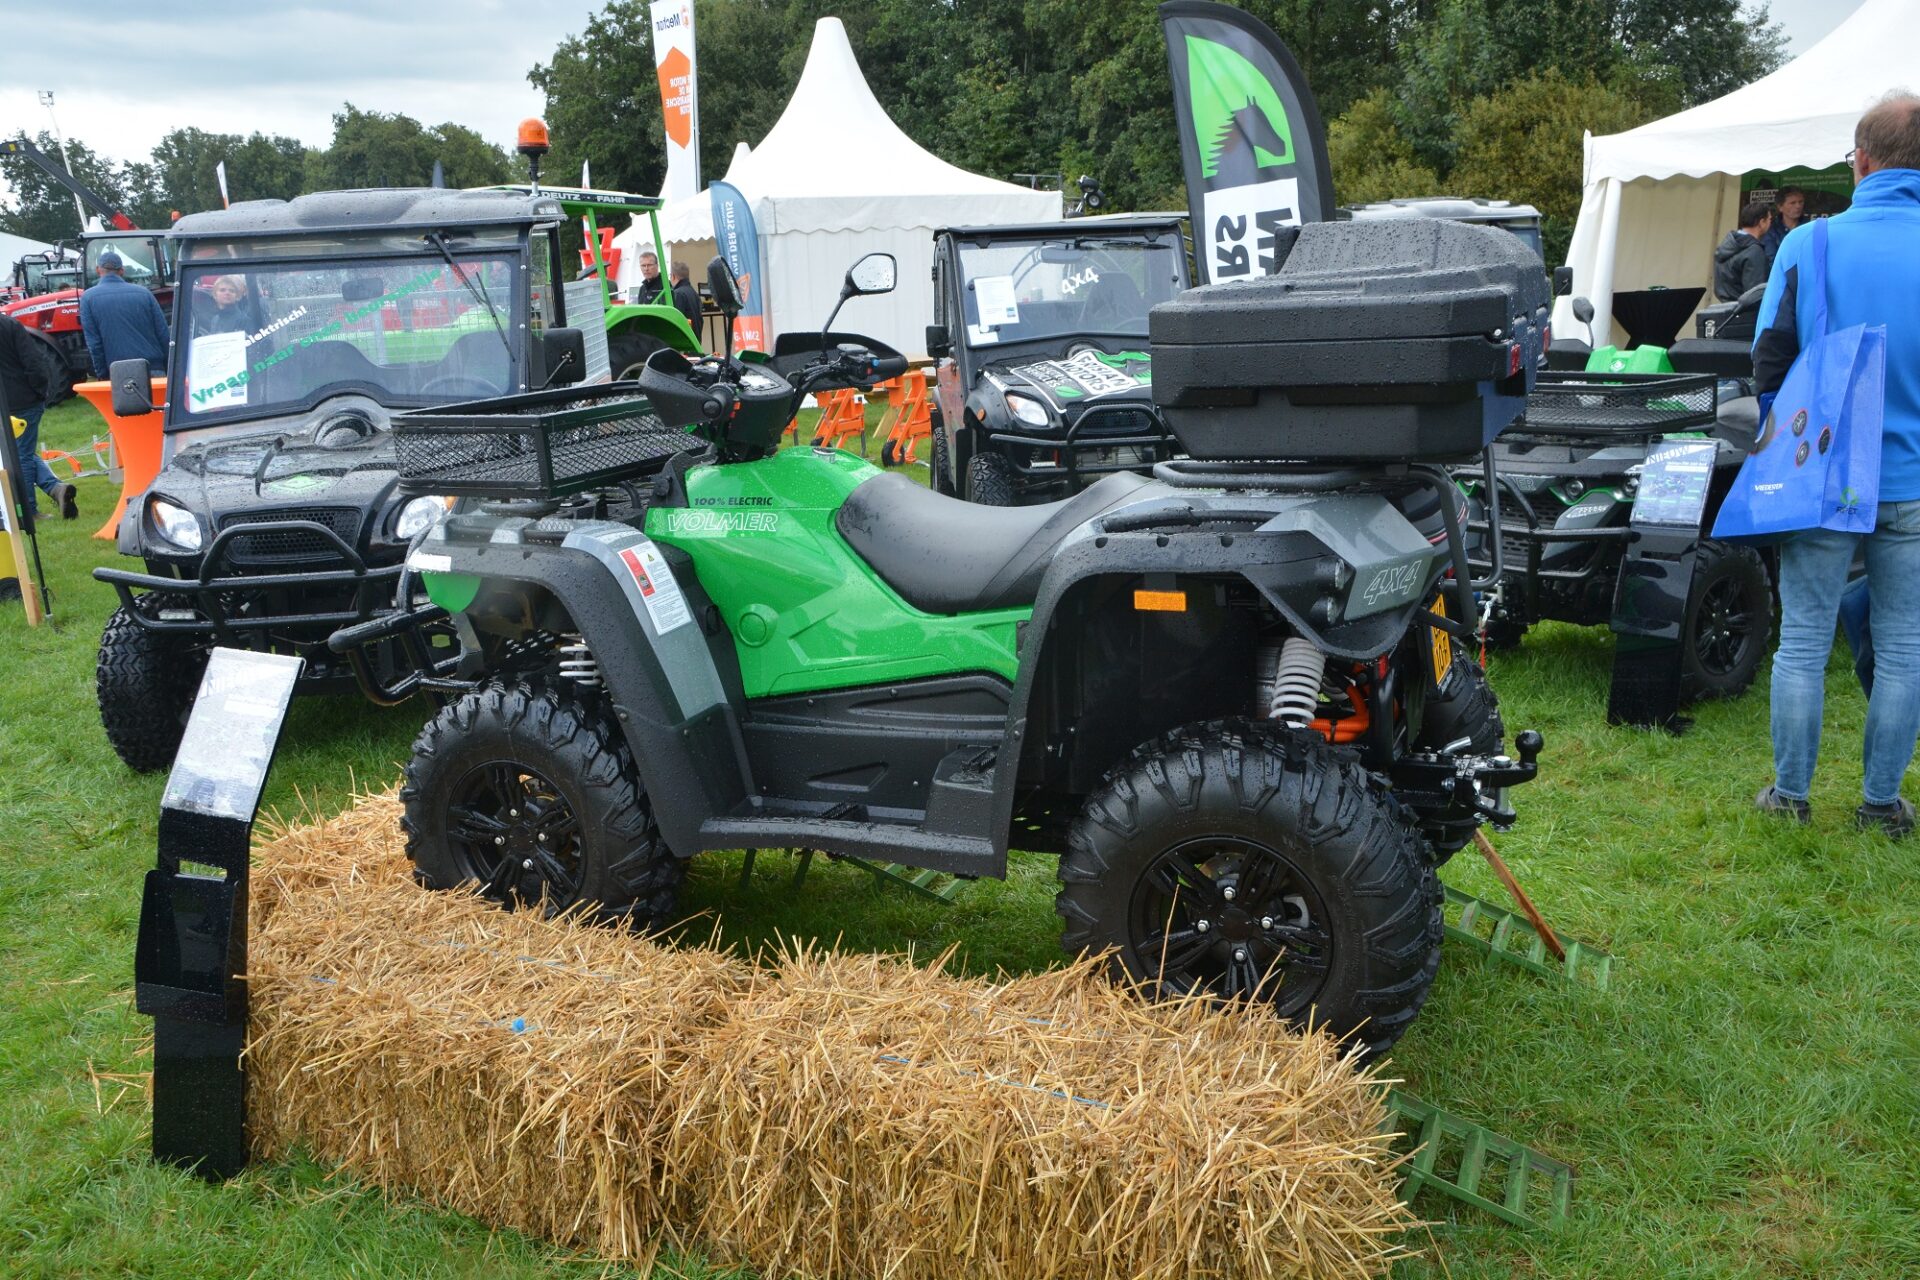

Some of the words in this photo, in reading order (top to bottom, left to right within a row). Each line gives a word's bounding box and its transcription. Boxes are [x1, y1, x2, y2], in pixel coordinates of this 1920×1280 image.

[541, 191, 581, 201] DEUTZ
[597, 195, 626, 204] FAHR
[192, 370, 251, 404] Vraag
[253, 344, 295, 374] naar
[1058, 362, 1110, 392] MOTORS
[694, 497, 725, 506] 100%
[728, 497, 773, 506] ELECTRIC
[668, 512, 778, 532] VOLMER
[1363, 559, 1423, 606] 4X4
